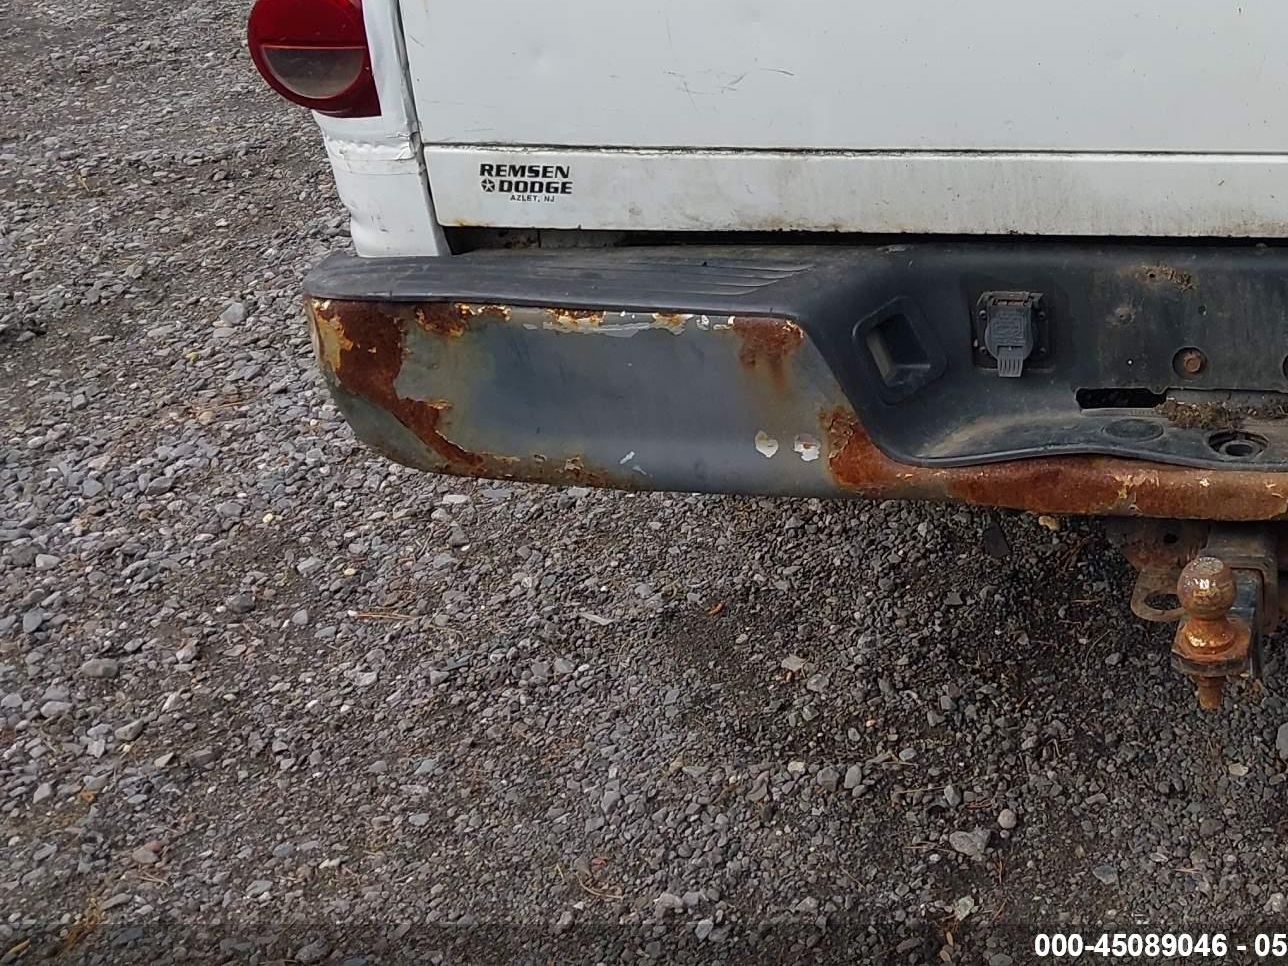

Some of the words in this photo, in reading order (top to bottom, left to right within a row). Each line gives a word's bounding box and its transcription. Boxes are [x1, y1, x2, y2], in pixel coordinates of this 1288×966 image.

[480, 163, 570, 179] REMSEN
[499, 180, 573, 194] DODGE
[544, 195, 555, 203] NJ
